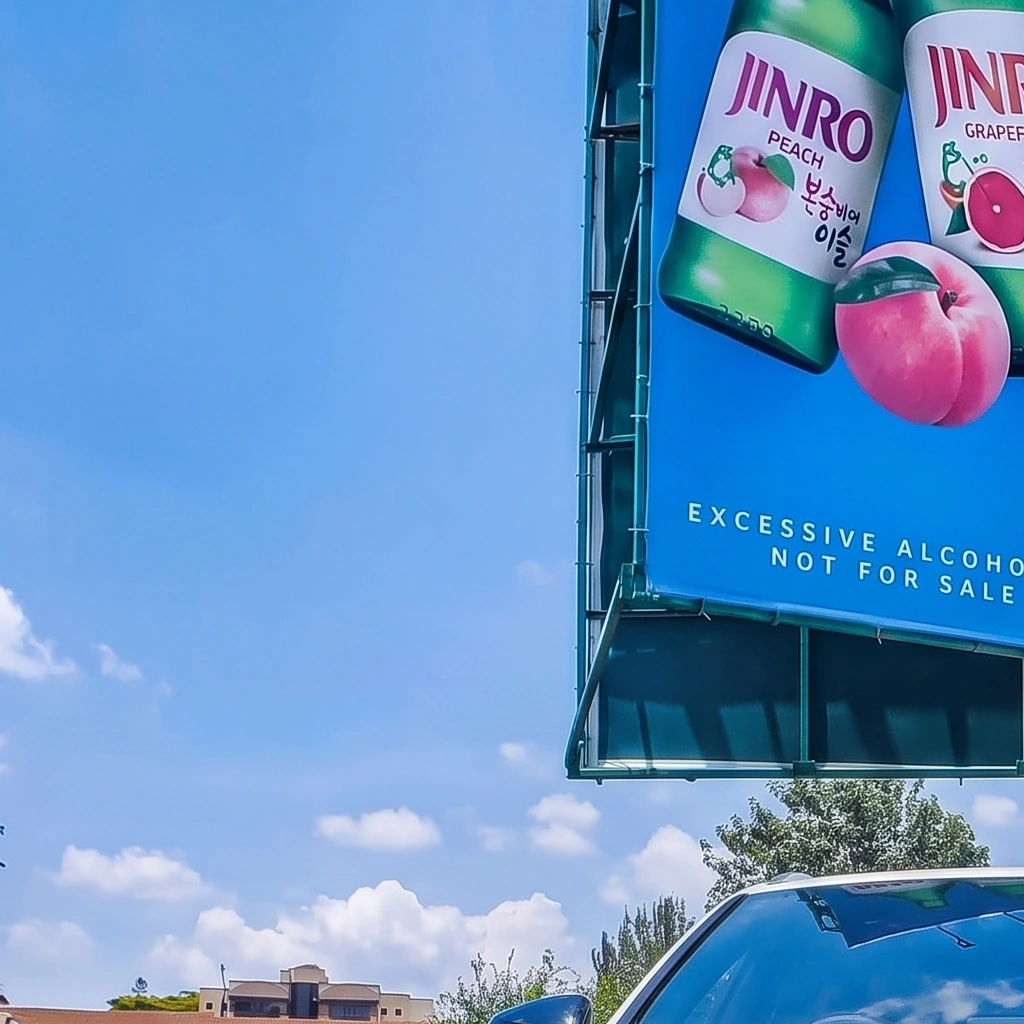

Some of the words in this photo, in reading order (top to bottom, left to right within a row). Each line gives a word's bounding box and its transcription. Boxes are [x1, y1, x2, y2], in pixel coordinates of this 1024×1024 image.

[724, 51, 874, 164] JINRO
[767, 130, 824, 170] PEACH
[814, 224, 852, 268] 이슬
[687, 501, 876, 554] EXCESSIVE
[771, 546, 837, 576] NOT
[858, 561, 919, 589] FOR
[939, 575, 1015, 605] SALE
